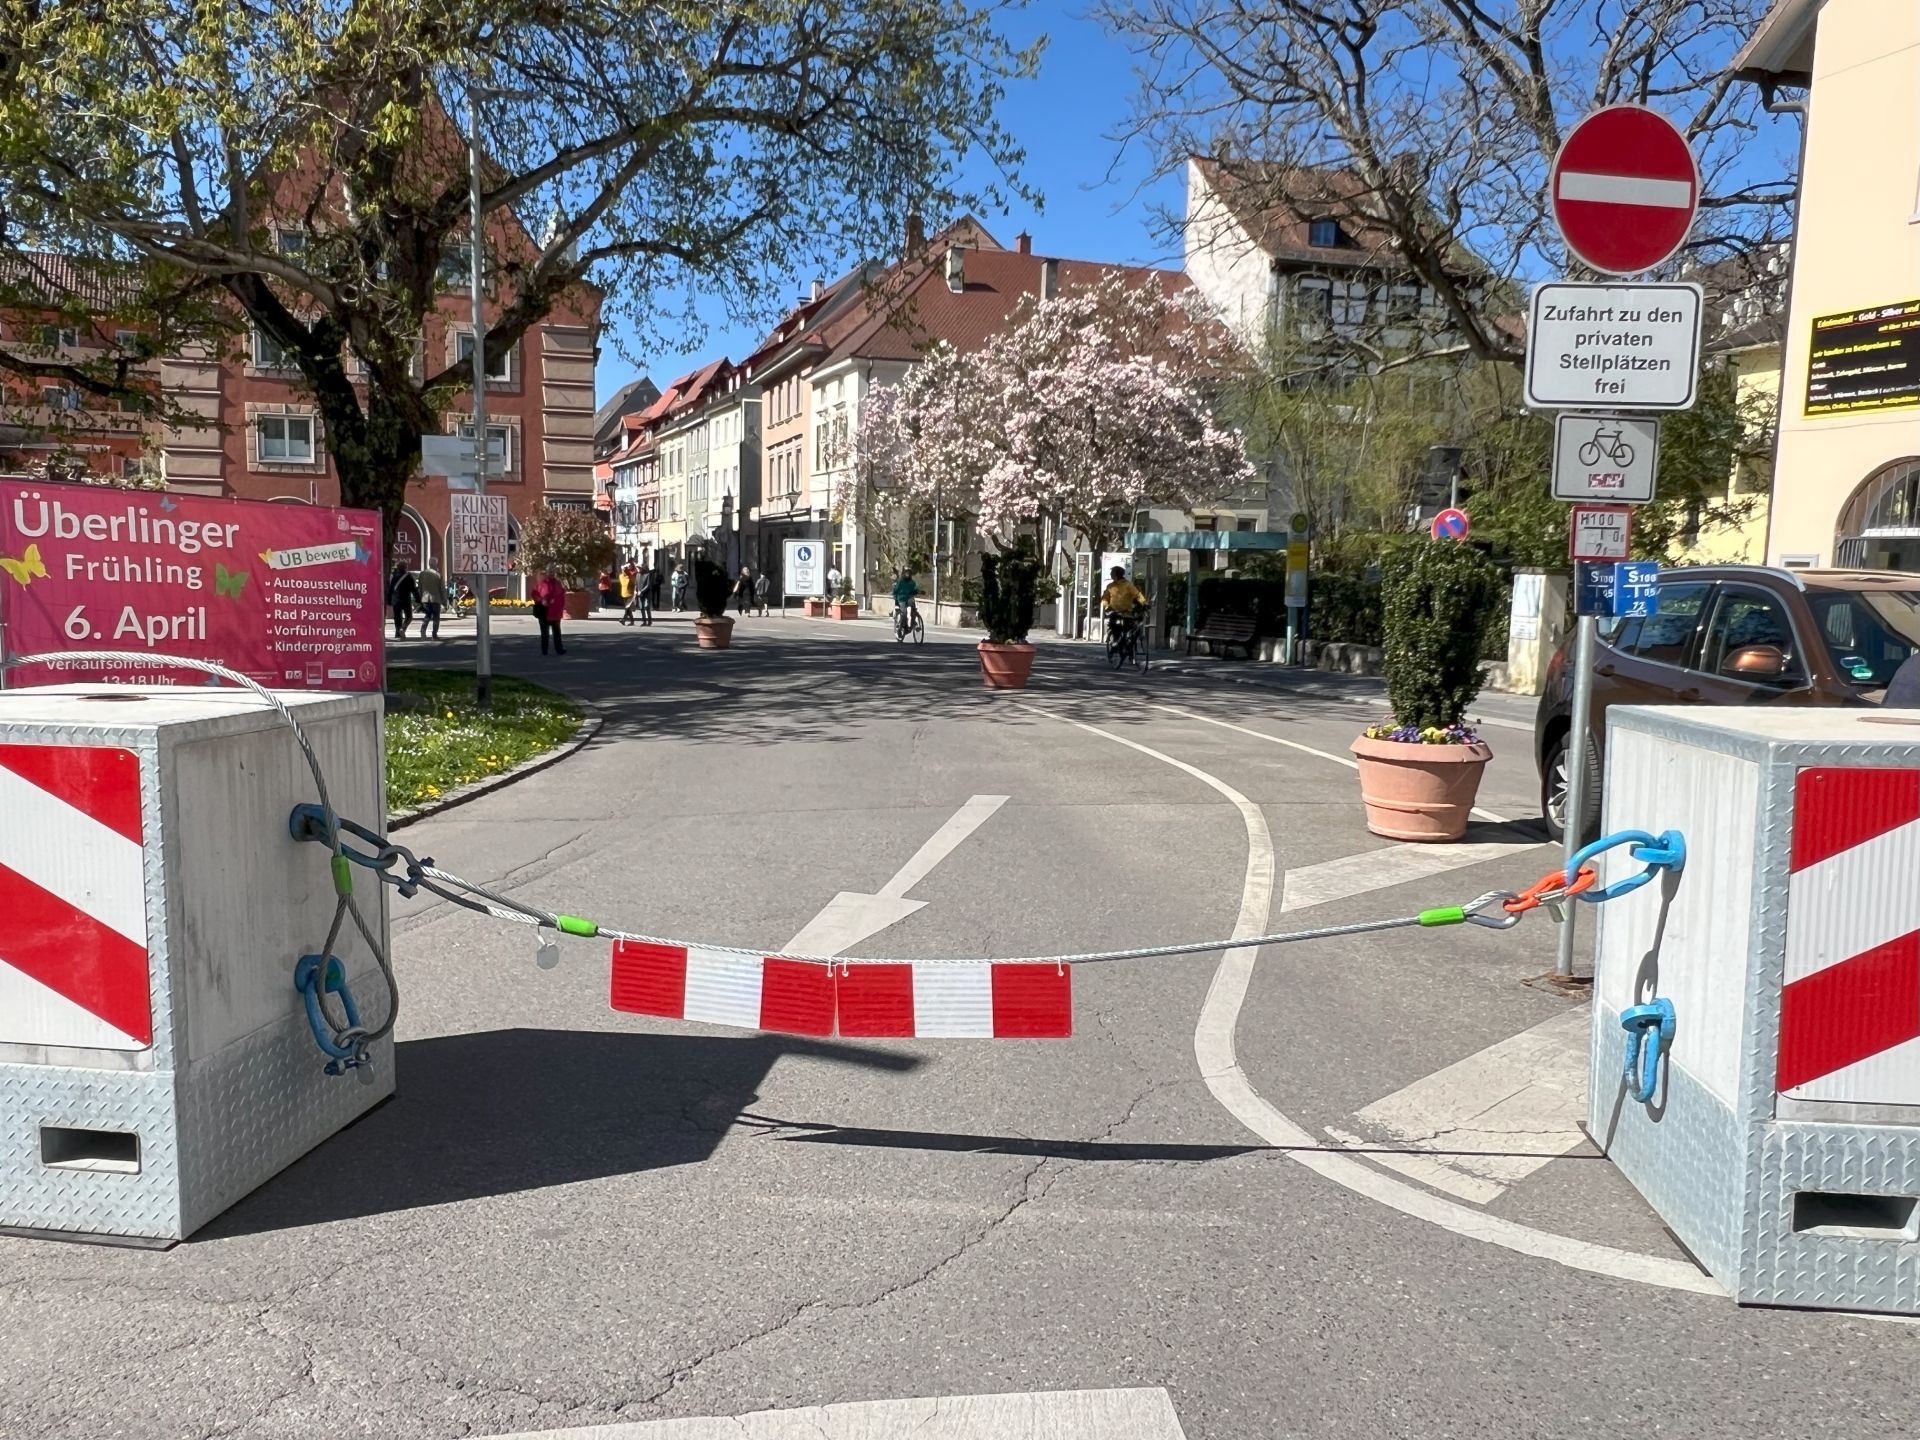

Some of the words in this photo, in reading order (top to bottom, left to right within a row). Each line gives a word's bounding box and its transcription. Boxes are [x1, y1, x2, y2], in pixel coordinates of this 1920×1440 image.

[1543, 305, 1614, 322] Zufahrt
[1618, 310, 1641, 322] zu
[1647, 307, 1683, 323] den
[1575, 330, 1653, 349] privaten
[1559, 353, 1671, 374] Stellplätzen
[1595, 378, 1626, 393] frei
[461, 495, 506, 515] KUNST
[13, 491, 240, 554] Überlinger
[462, 515, 490, 534] FREI
[1580, 513, 1614, 526] H100
[397, 531, 412, 542] EL
[484, 535, 506, 553] TAG
[280, 551, 302, 566] ÜB
[305, 546, 350, 562] bewegt
[393, 543, 417, 554] SEN
[66, 553, 203, 590] Frühling
[273, 577, 368, 595] Autoausstellung
[274, 592, 363, 609] Radausstellung
[274, 609, 298, 620] Rad
[301, 609, 352, 621] Parcours
[64, 605, 102, 640] 6.
[113, 606, 206, 647] April
[274, 625, 356, 638] Vorführungen
[275, 641, 373, 654] Kinderprogramm
